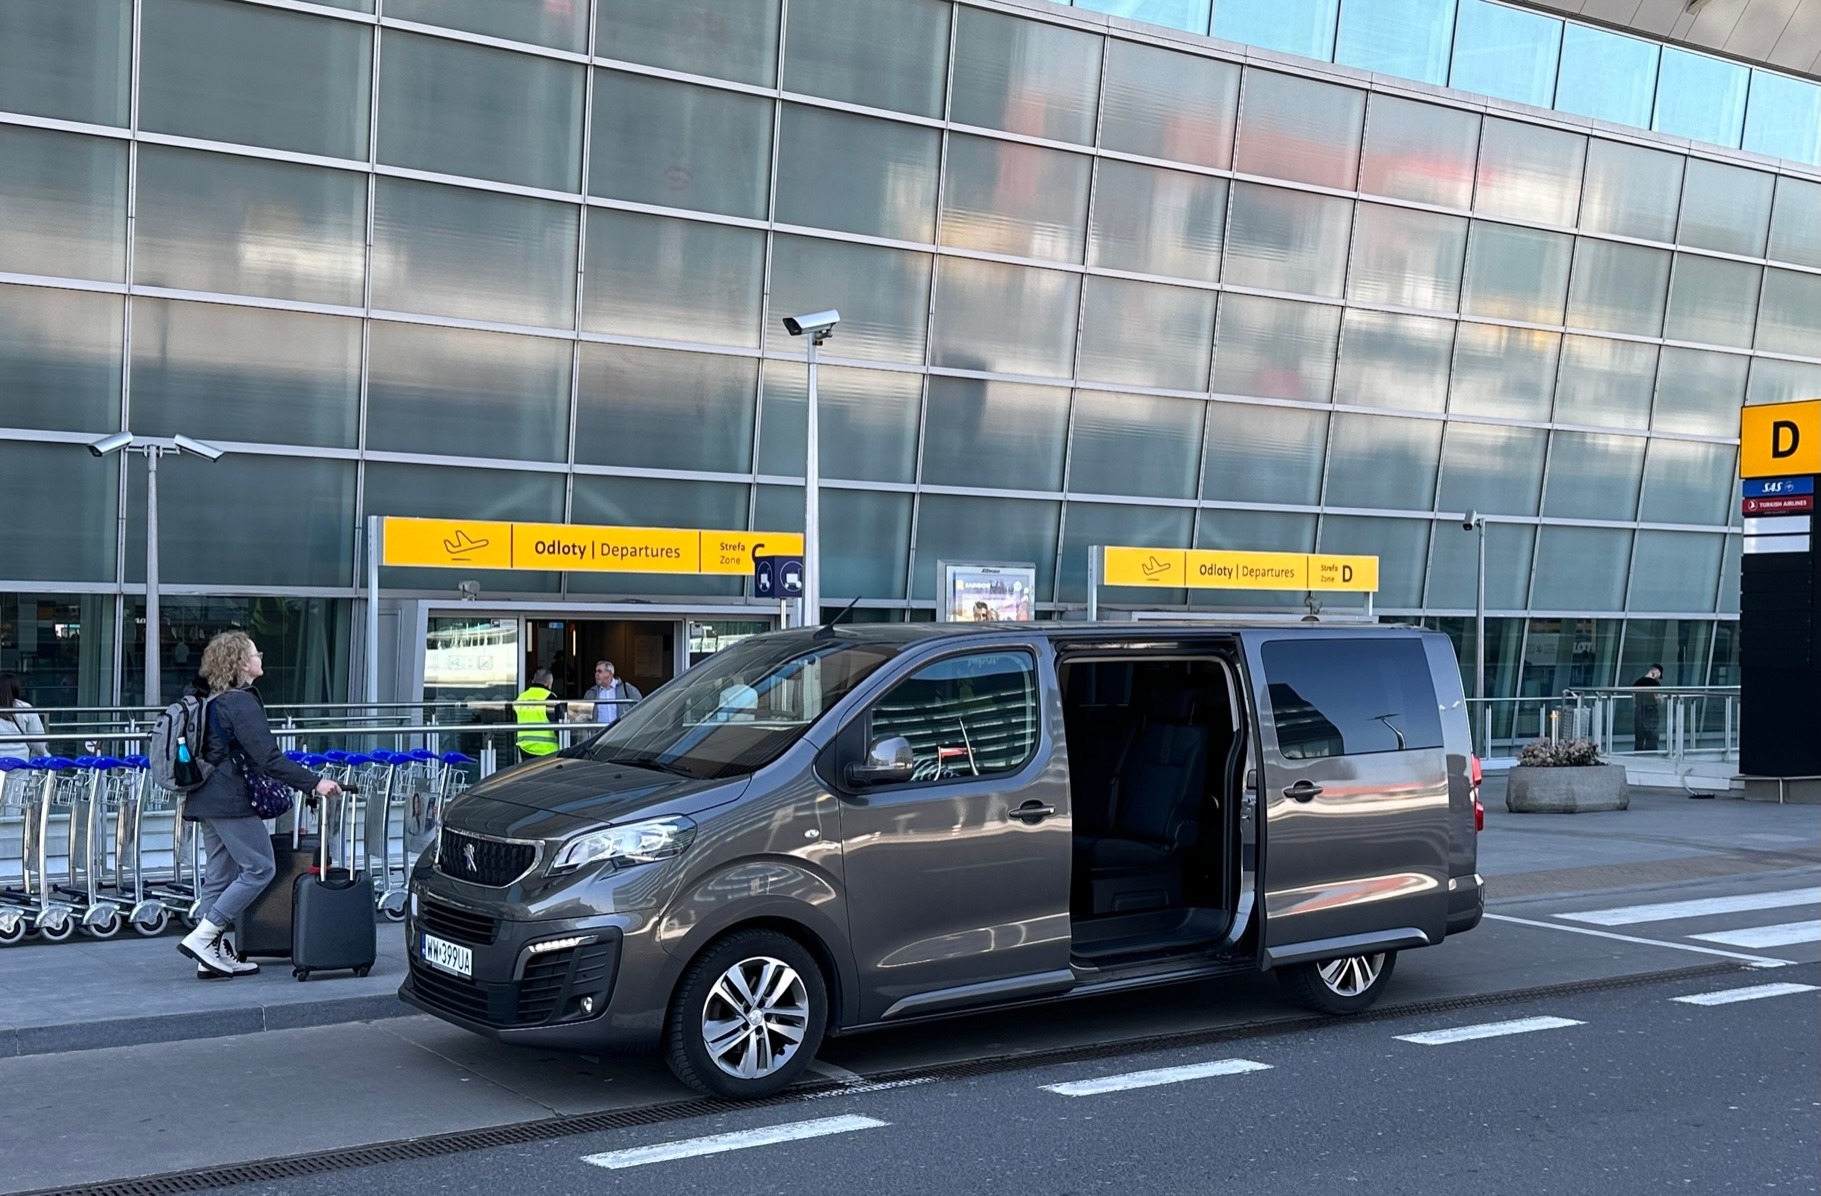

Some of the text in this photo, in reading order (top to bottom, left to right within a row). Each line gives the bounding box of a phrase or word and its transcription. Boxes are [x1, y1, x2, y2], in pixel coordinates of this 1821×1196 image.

[1771, 420, 1800, 459] D
[1761, 481, 1783, 493] SAS
[1759, 499, 1807, 509] TURKISH AIRLINES
[534, 539, 681, 560] Odloty Departures
[720, 542, 746, 552] Strefa
[720, 555, 741, 565] Zone
[1199, 563, 1295, 580] Odloty Departures
[1320, 564, 1339, 572] Strefa
[1342, 564, 1354, 583] D
[1320, 574, 1335, 583] Zone
